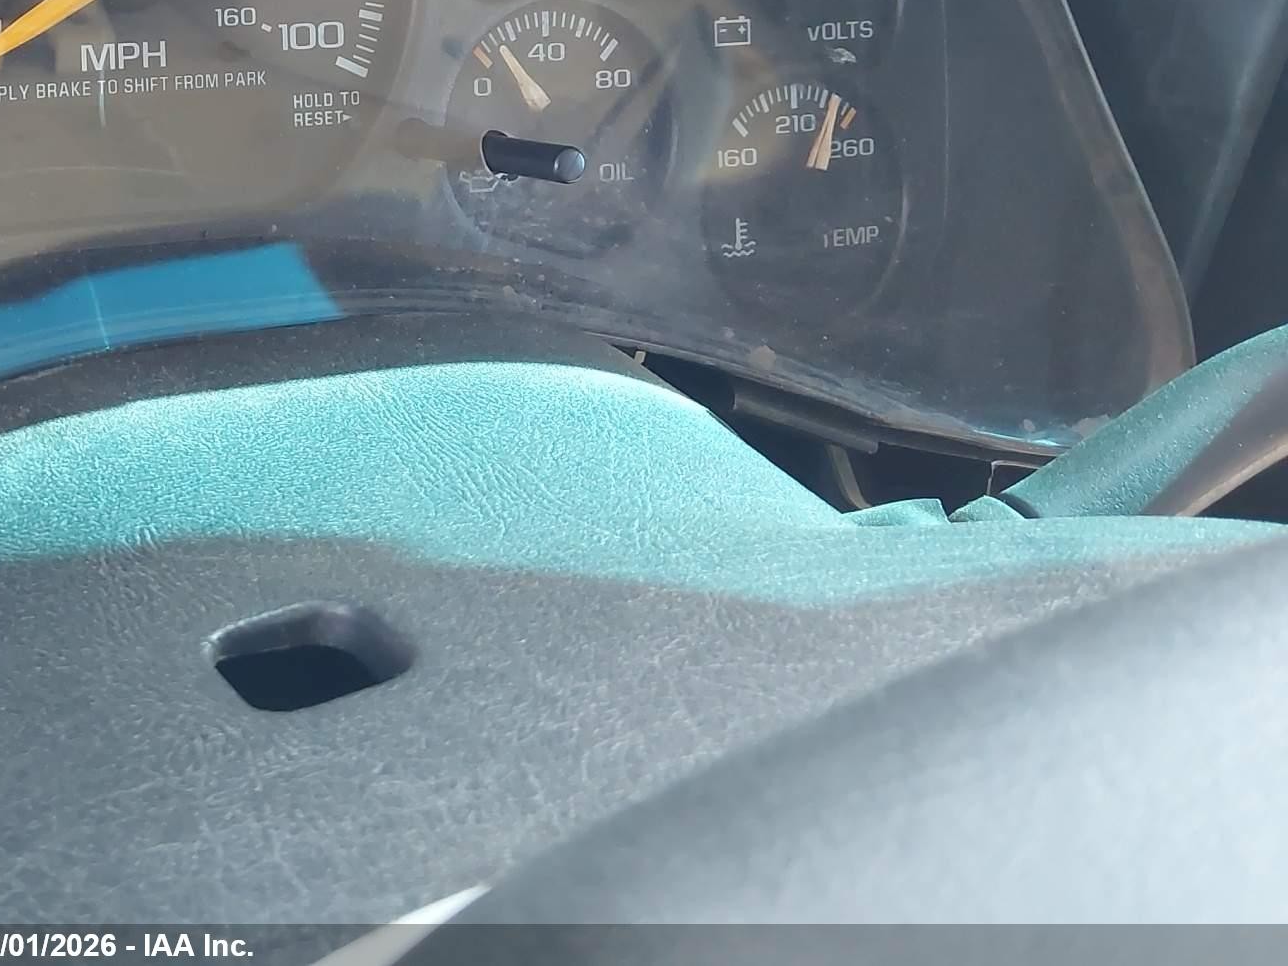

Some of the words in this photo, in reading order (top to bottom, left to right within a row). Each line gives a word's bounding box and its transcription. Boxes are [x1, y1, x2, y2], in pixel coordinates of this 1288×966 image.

[215, 7, 256, 27] 160
[278, 21, 345, 50] 100
[807, 20, 873, 41] VOLTS
[80, 41, 168, 73] MPH
[528, 43, 565, 62] 40
[35, 79, 92, 99] BRAKE
[97, 78, 119, 95] TO
[123, 76, 169, 94] SHIFT
[174, 73, 219, 91] FROM
[224, 71, 267, 88] PARK
[473, 78, 492, 96] 0
[595, 69, 631, 88] 80
[294, 92, 334, 109] HOLD
[340, 91, 360, 106] TO
[294, 110, 343, 127] RESET
[775, 114, 816, 134] 210
[716, 148, 758, 167] 160
[830, 138, 874, 158] 260
[599, 162, 634, 182] OIL
